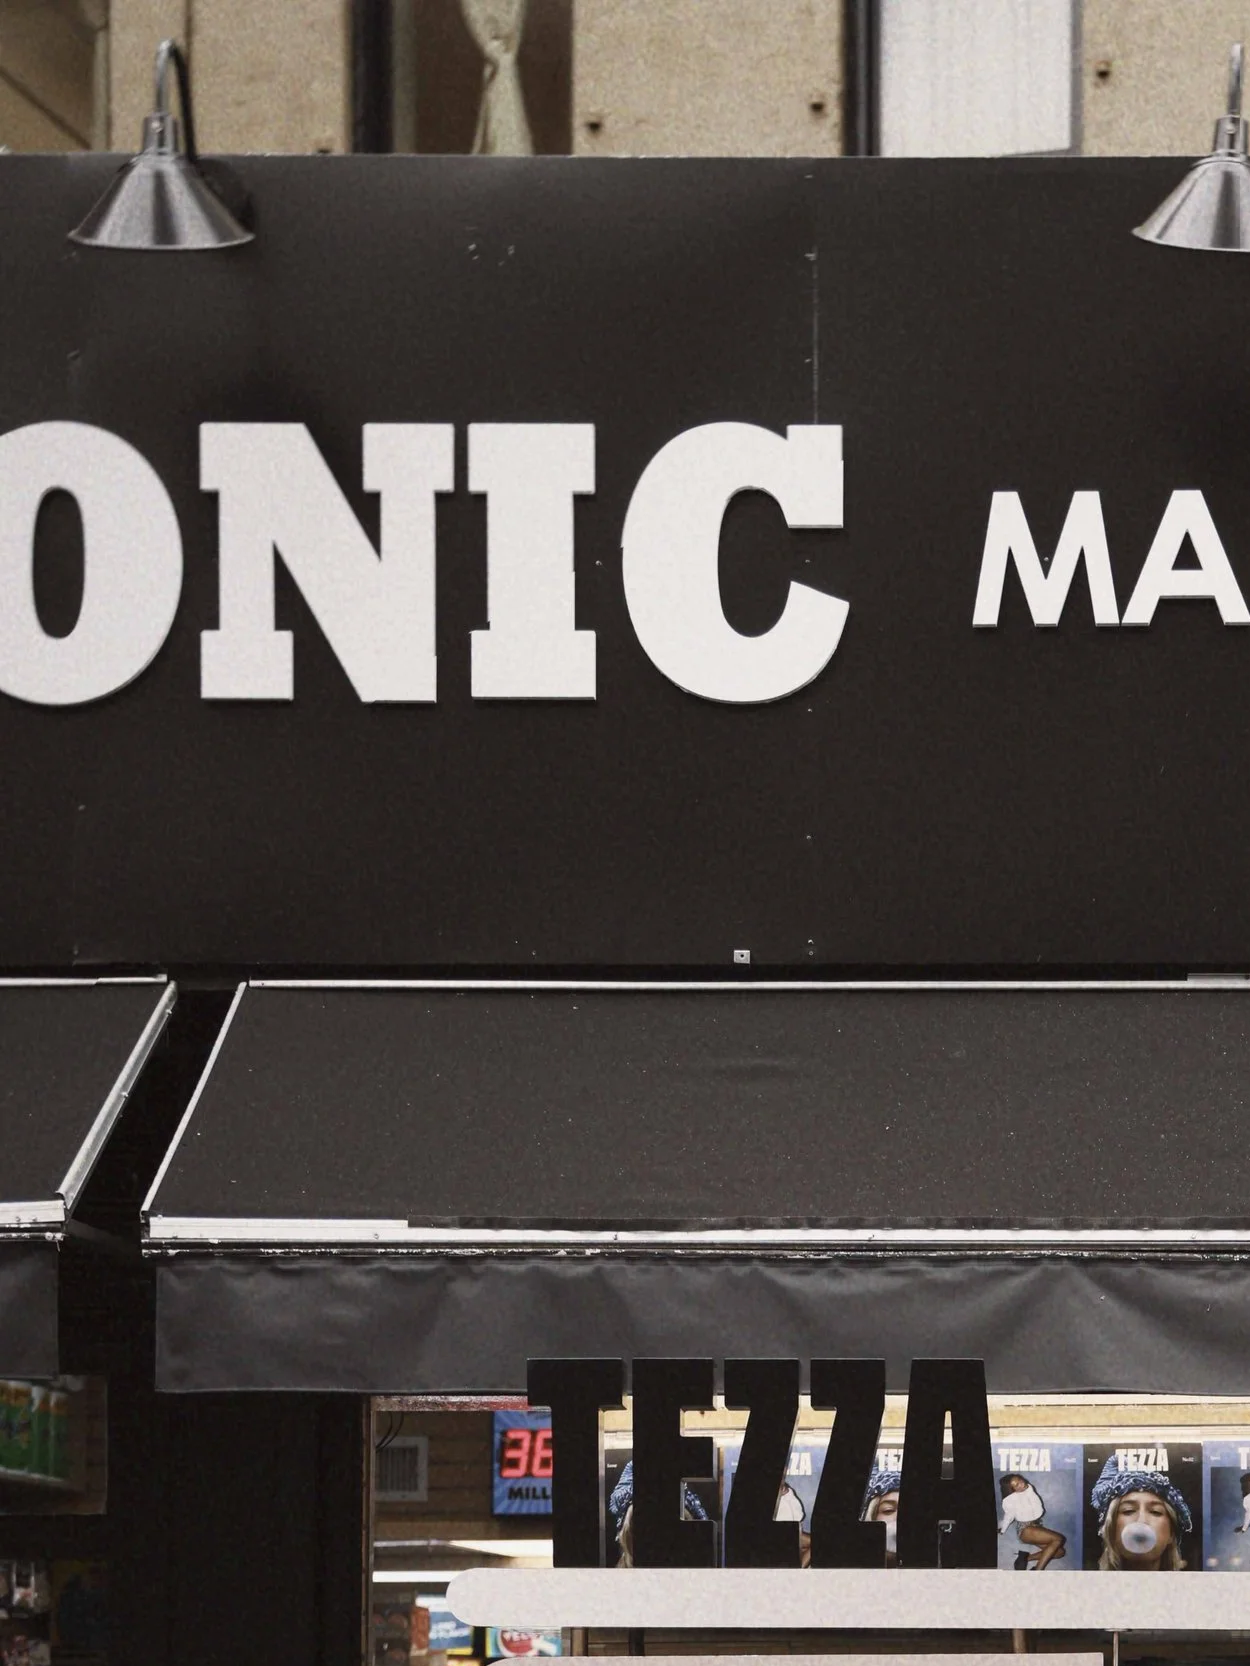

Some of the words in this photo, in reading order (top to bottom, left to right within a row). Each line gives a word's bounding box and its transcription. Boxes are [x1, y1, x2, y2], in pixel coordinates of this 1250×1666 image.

[0, 420, 850, 704] ONIC
[526, 1357, 999, 1568] TEZZA
[998, 1448, 1051, 1472] TEZZA
[1115, 1448, 1169, 1472] TEZZA
